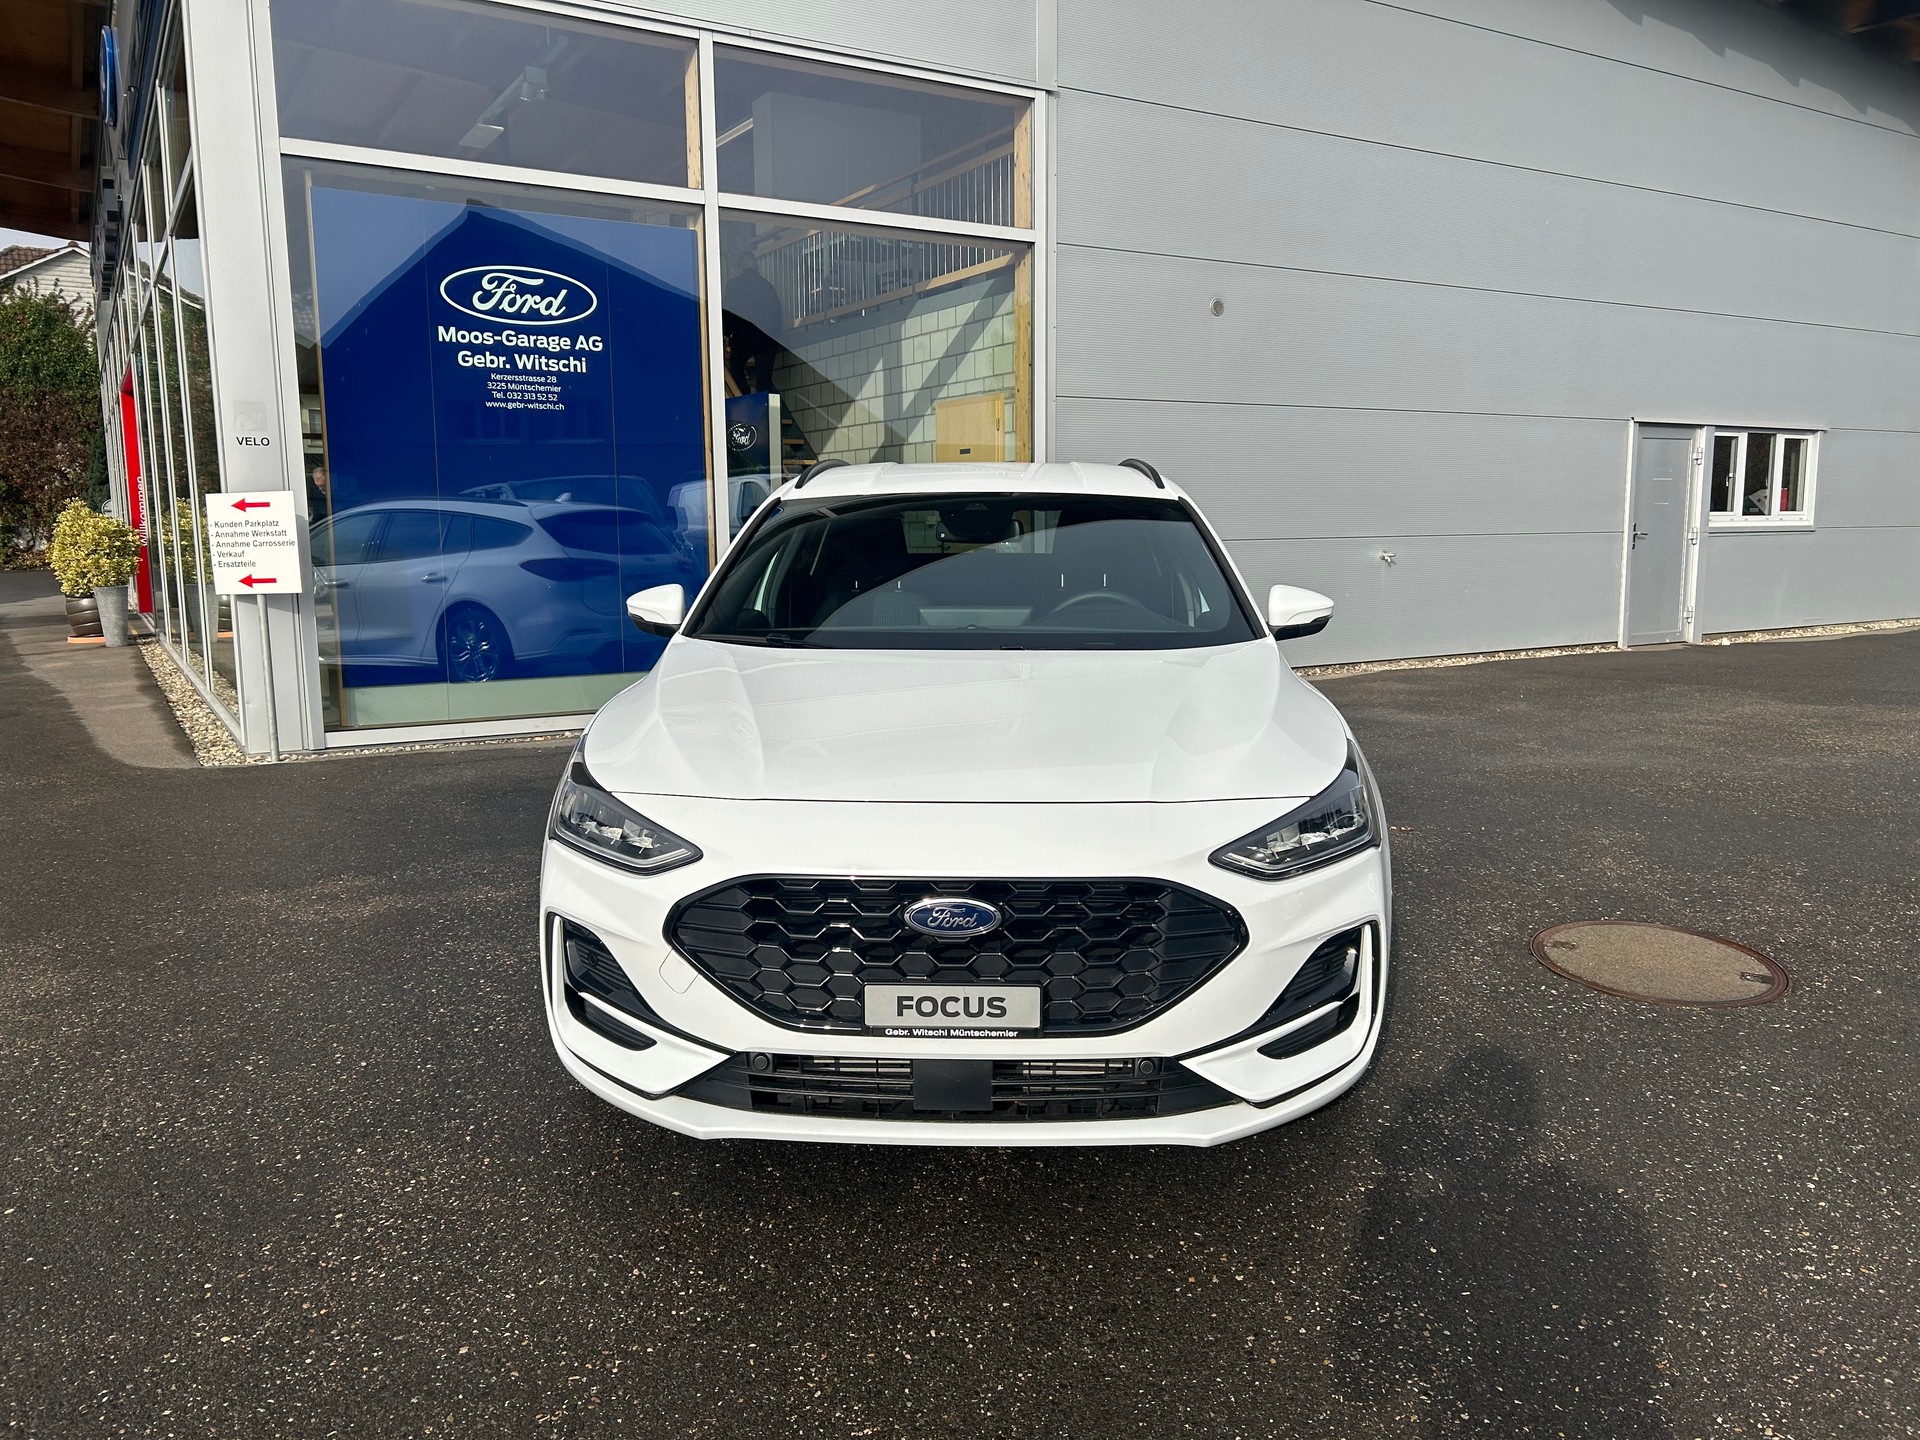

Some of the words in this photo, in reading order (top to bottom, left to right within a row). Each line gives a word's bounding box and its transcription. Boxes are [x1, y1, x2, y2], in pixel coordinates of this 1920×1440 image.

[472, 272, 568, 317] Ford
[438, 326, 571, 352] Moos-Garage
[575, 335, 603, 351] AG
[457, 350, 511, 369] Gebr.
[514, 353, 587, 373] Witschi
[490, 372, 546, 383] Kerzersstrasse
[546, 375, 557, 383] 28
[486, 381, 507, 390] 3225
[491, 390, 505, 399] Tel.
[506, 391, 521, 400] 032
[523, 392, 536, 400] 313
[537, 393, 547, 401] 52
[548, 393, 558, 401] 52
[485, 400, 565, 411] www.gebr-witschi.ch
[236, 436, 270, 446] VELO
[214, 521, 243, 529] Kunden
[244, 519, 280, 530] Parkplatz
[251, 529, 288, 538] Werkstatt
[216, 540, 251, 548] Annahme
[252, 538, 296, 548] Carrosserie
[217, 550, 245, 558] Verkauf
[218, 560, 257, 568] Ersatzteile
[927, 906, 977, 928] Ford
[896, 995, 1008, 1018] FOCUS
[885, 1028, 910, 1036] Gebr.
[912, 1028, 948, 1037] Witschi
